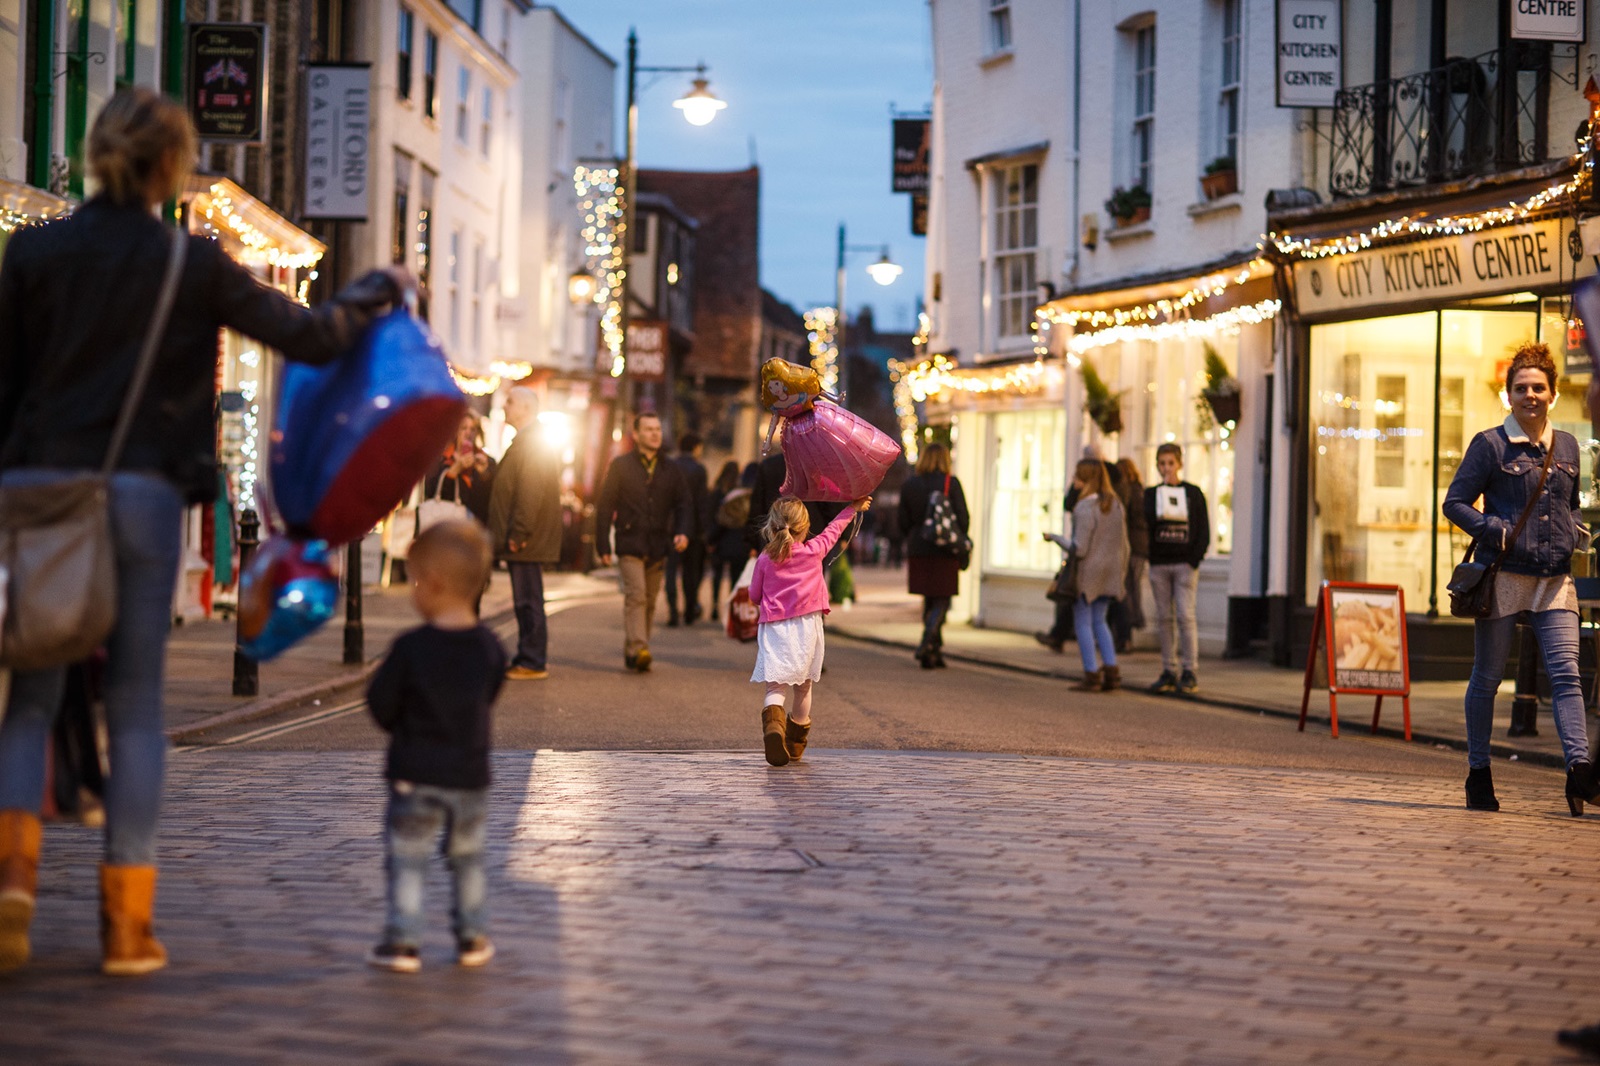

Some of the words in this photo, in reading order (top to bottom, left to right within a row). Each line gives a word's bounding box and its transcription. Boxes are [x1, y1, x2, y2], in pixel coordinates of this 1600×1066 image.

[1518, 0, 1576, 17] CENTRE
[1293, 14, 1327, 30] CITY
[1280, 42, 1338, 59] KITCHEN
[1284, 71, 1335, 87] CENTRE
[310, 73, 330, 209] GALLERY
[343, 88, 368, 197] LILFORD
[1336, 258, 1373, 299] CITY
[1383, 244, 1463, 292] KITCHEN
[1472, 231, 1552, 281] CENTRE
